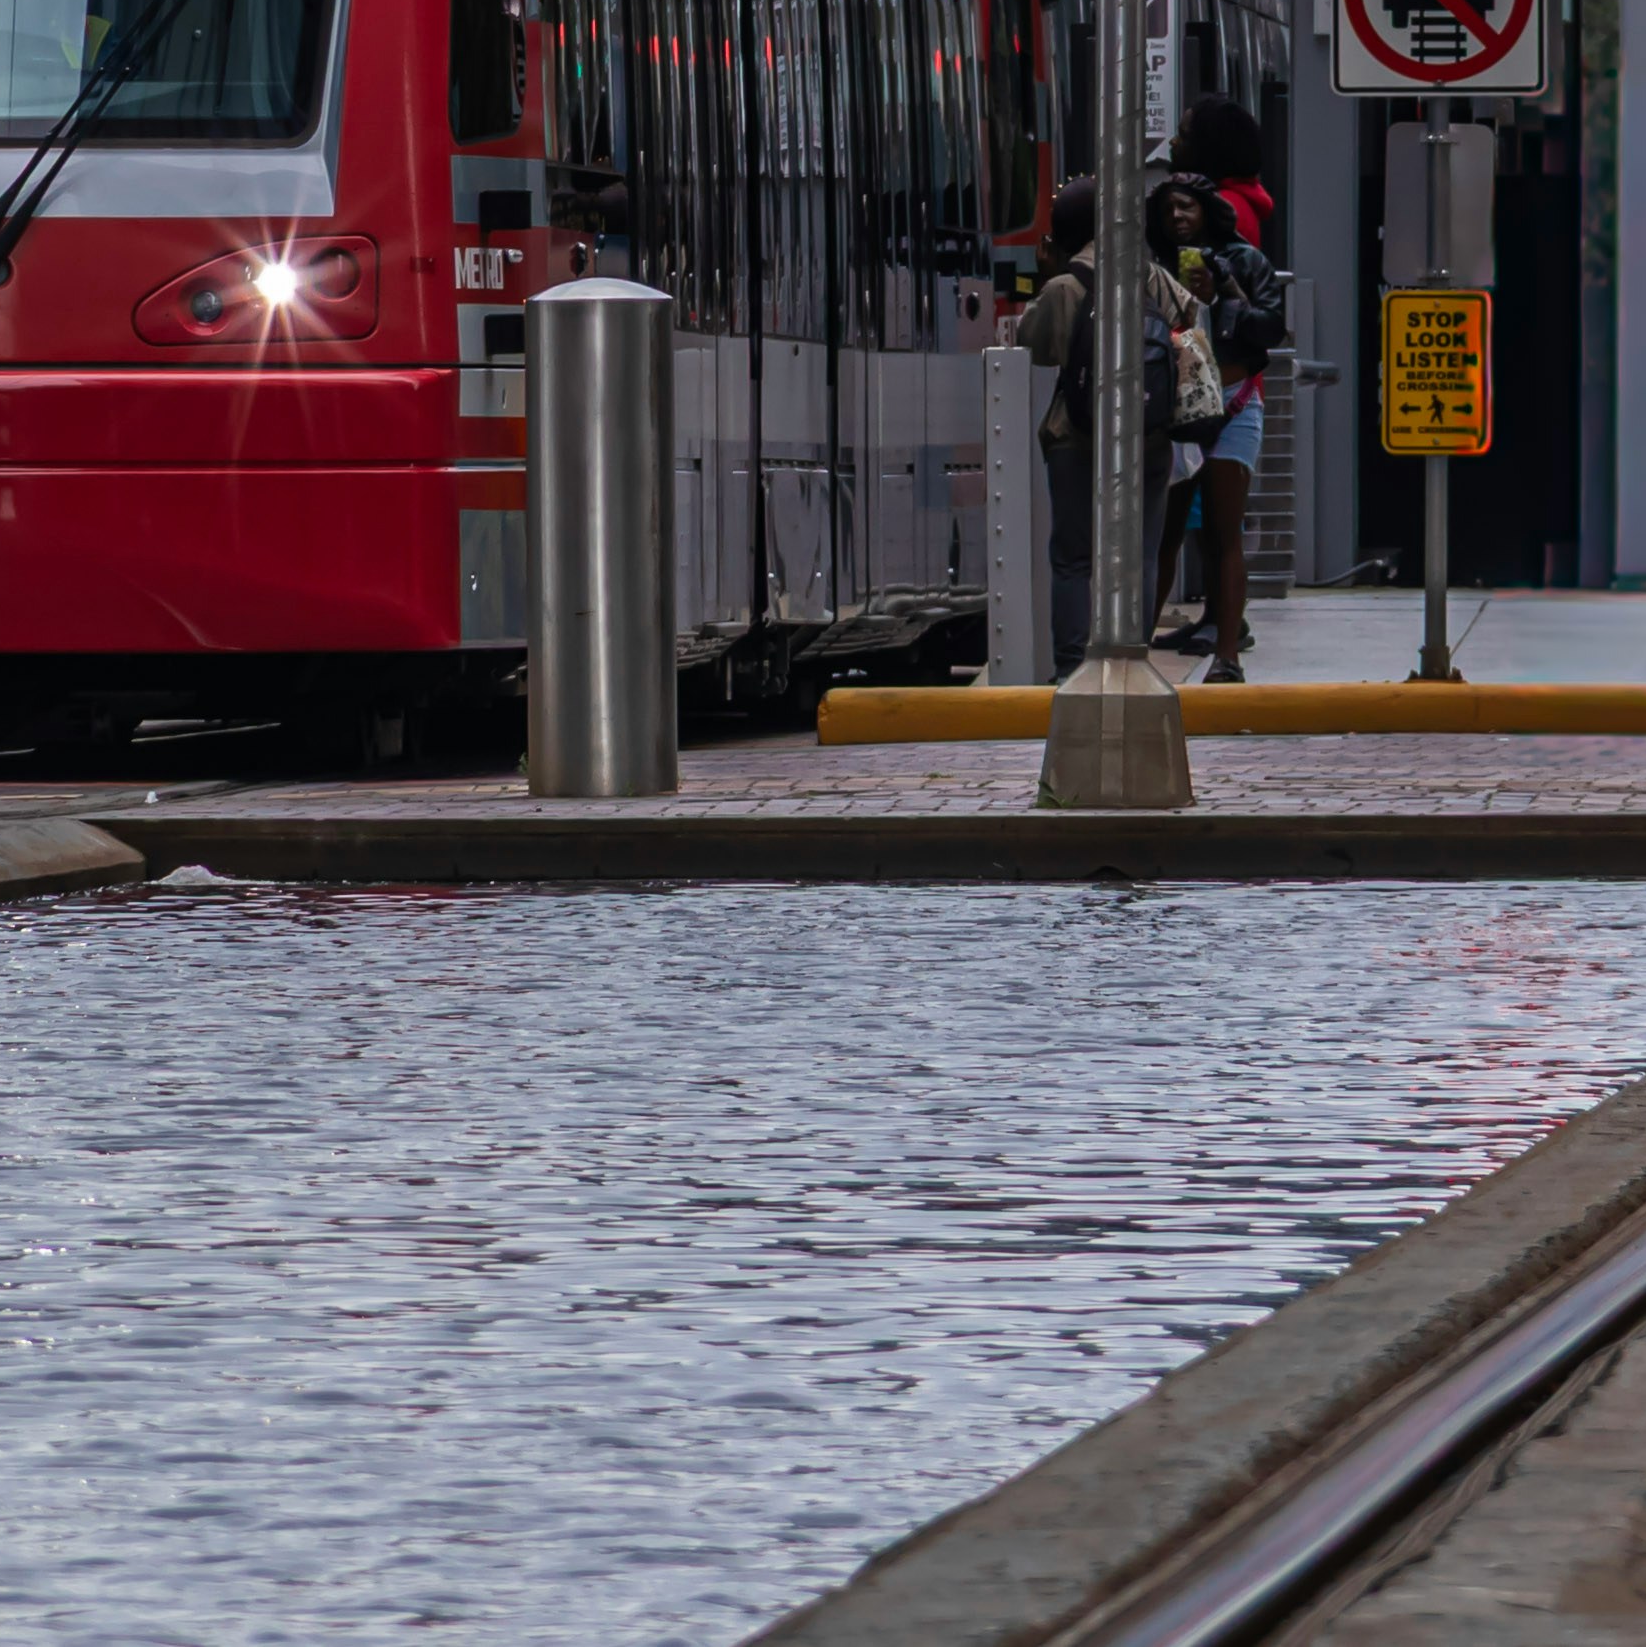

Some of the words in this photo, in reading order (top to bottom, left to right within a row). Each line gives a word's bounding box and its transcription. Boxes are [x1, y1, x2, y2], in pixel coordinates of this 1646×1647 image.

[454, 247, 504, 290] METRO
[1407, 311, 1466, 328] STOP
[1405, 331, 1466, 347] LOOK
[1396, 351, 1477, 368] LISTEN
